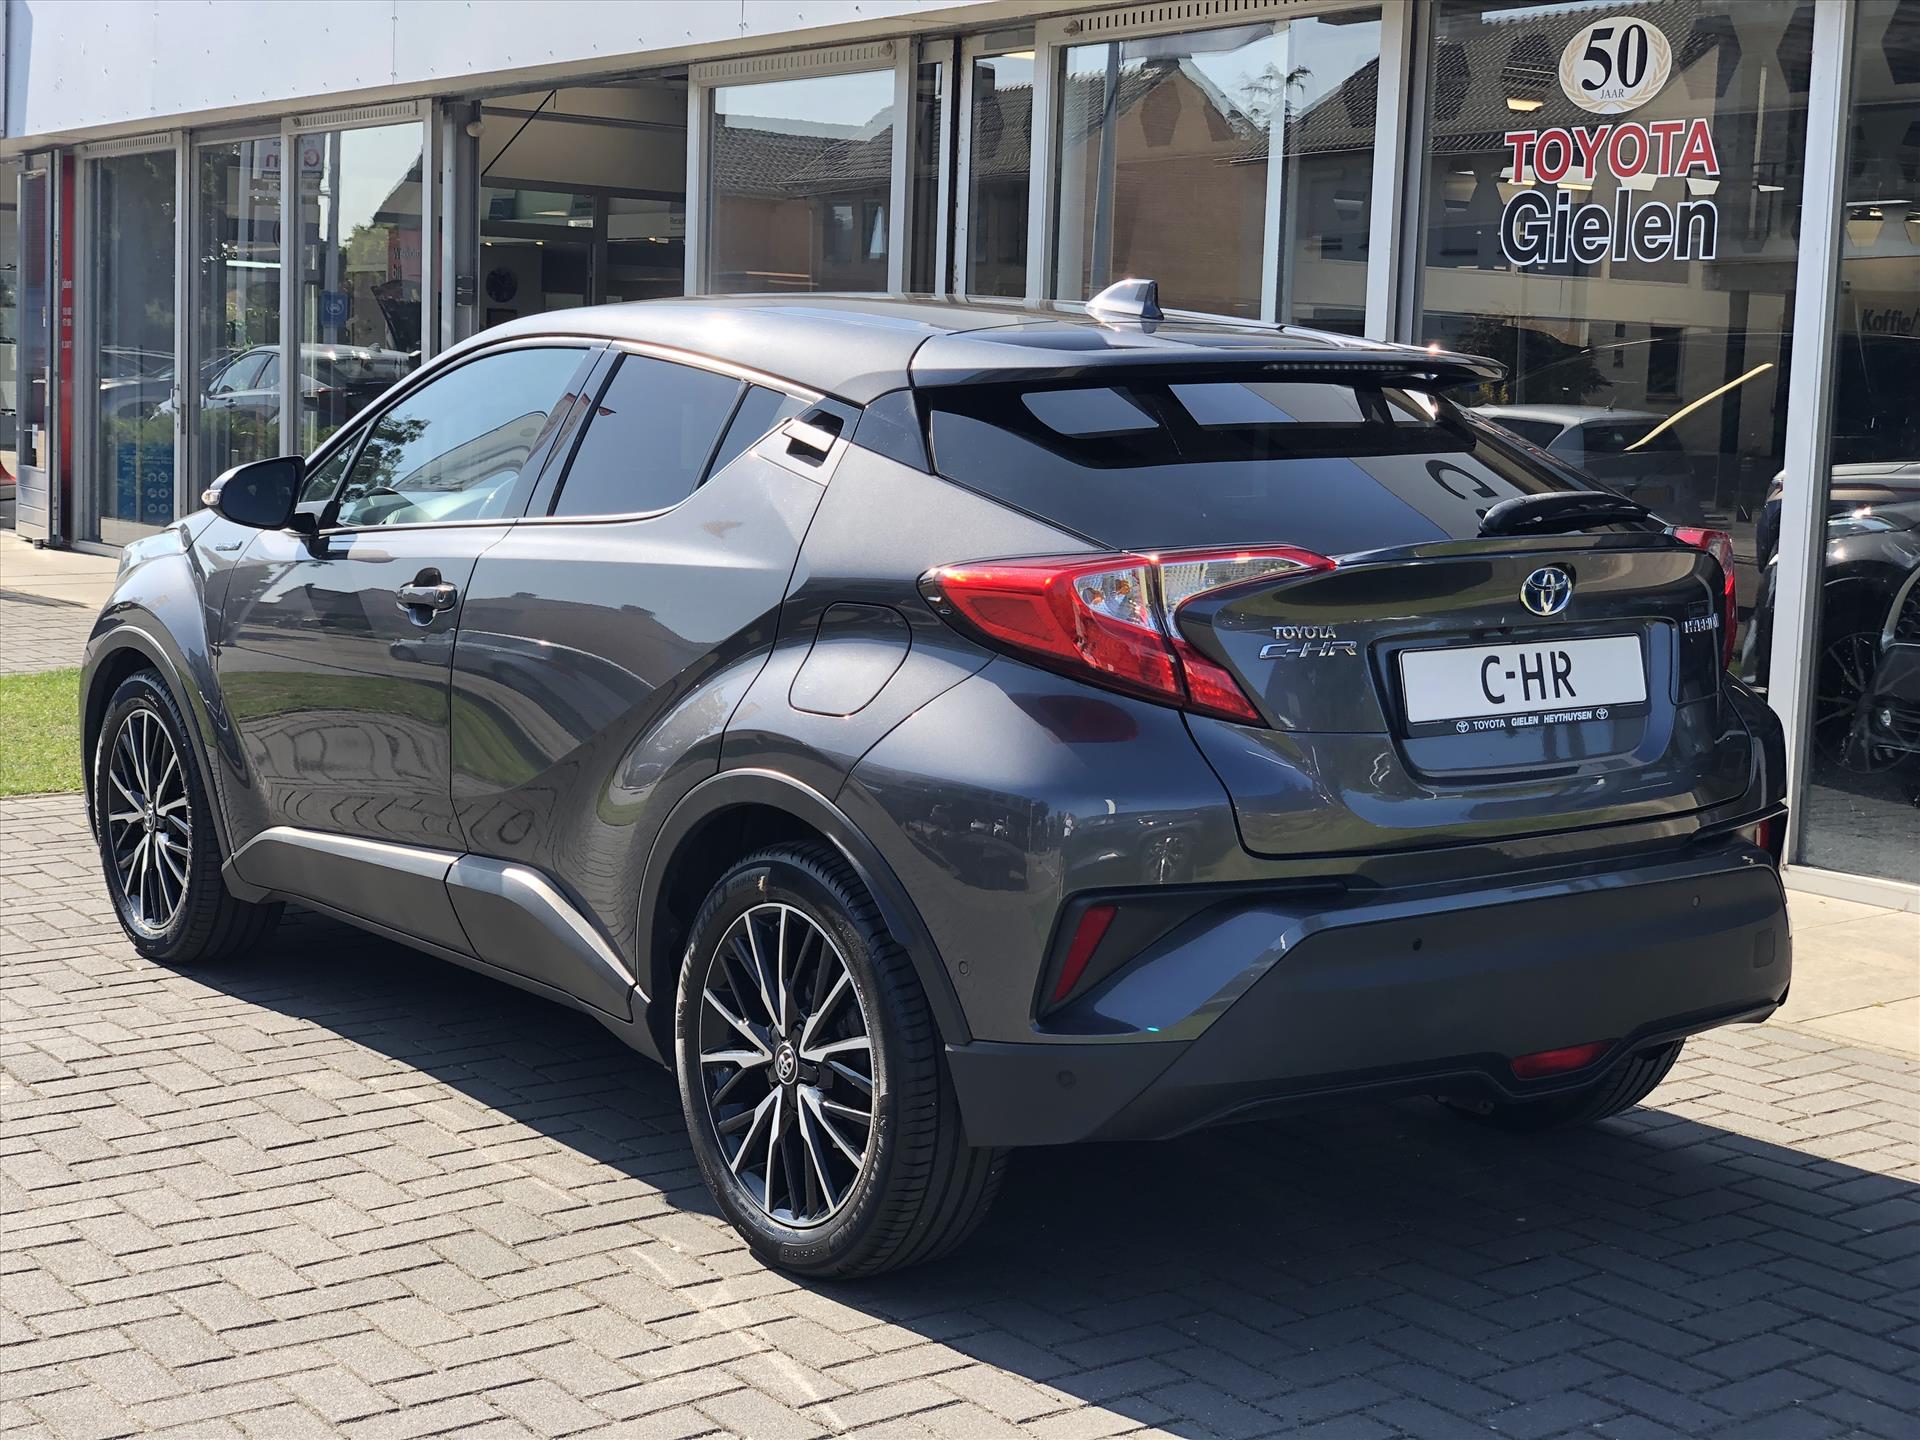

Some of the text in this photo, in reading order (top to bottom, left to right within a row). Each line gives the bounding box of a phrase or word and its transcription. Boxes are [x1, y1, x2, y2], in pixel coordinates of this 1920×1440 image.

[1581, 24, 1648, 91] 50
[1600, 89, 1625, 100] JAAR
[1504, 118, 1721, 186] TOYOTA
[1501, 187, 1719, 266] Gielen
[1259, 640, 1358, 659] C-HR
[1272, 625, 1337, 640] TOYOTA
[1480, 650, 1577, 705] C-HR
[1472, 710, 1593, 731] TOYOTA GIELEN HEYTHUYSEN
